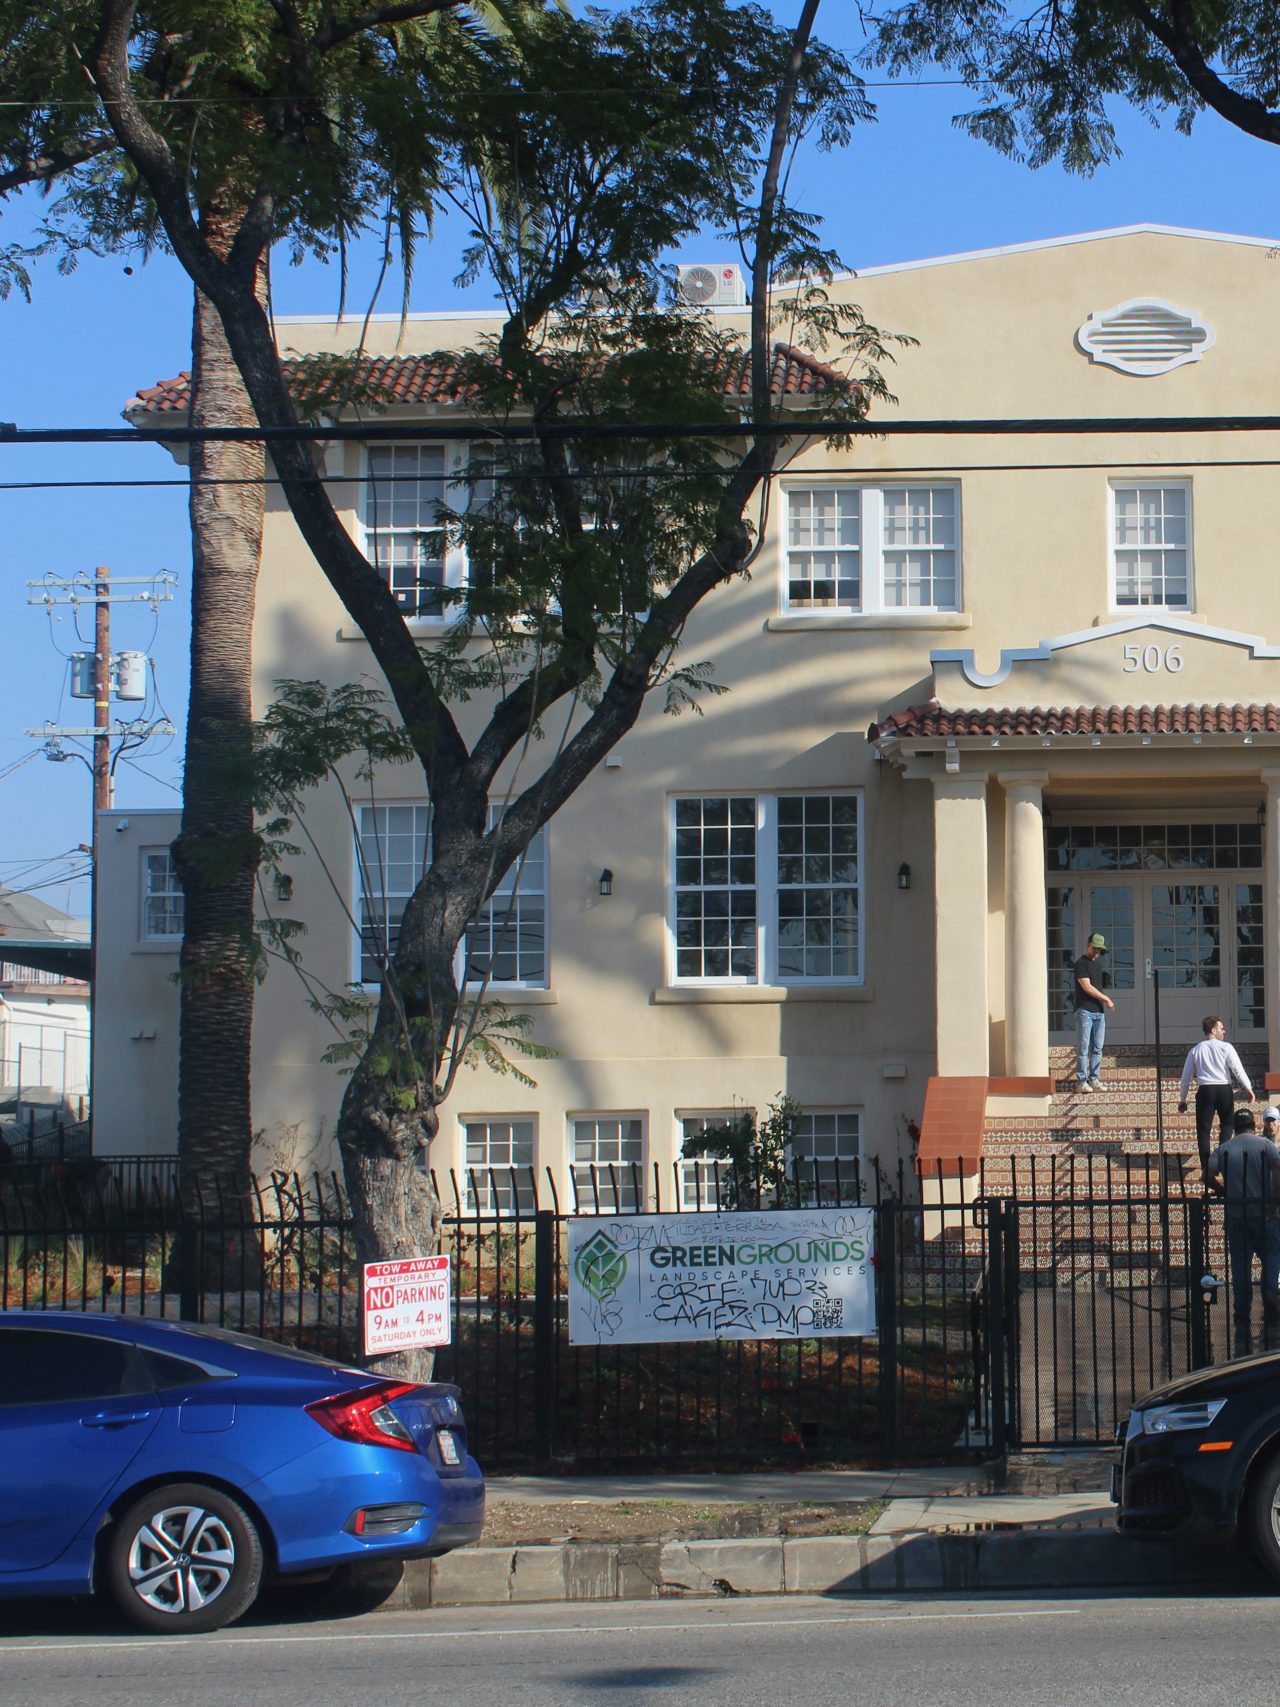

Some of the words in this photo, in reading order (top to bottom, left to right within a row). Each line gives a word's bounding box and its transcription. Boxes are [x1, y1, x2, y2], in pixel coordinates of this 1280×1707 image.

[1122, 643, 1184, 673] 506
[650, 1240, 865, 1269] GREENGROUNDS
[378, 1272, 437, 1285] TEMPORARY
[650, 1269, 761, 1283] LANDSCAPE
[775, 1265, 866, 1278] SERVICES
[370, 1287, 393, 1309] NO
[396, 1284, 445, 1305] PARKING
[371, 1330, 417, 1344] SATURDAY
[420, 1327, 443, 1338] ONLY
